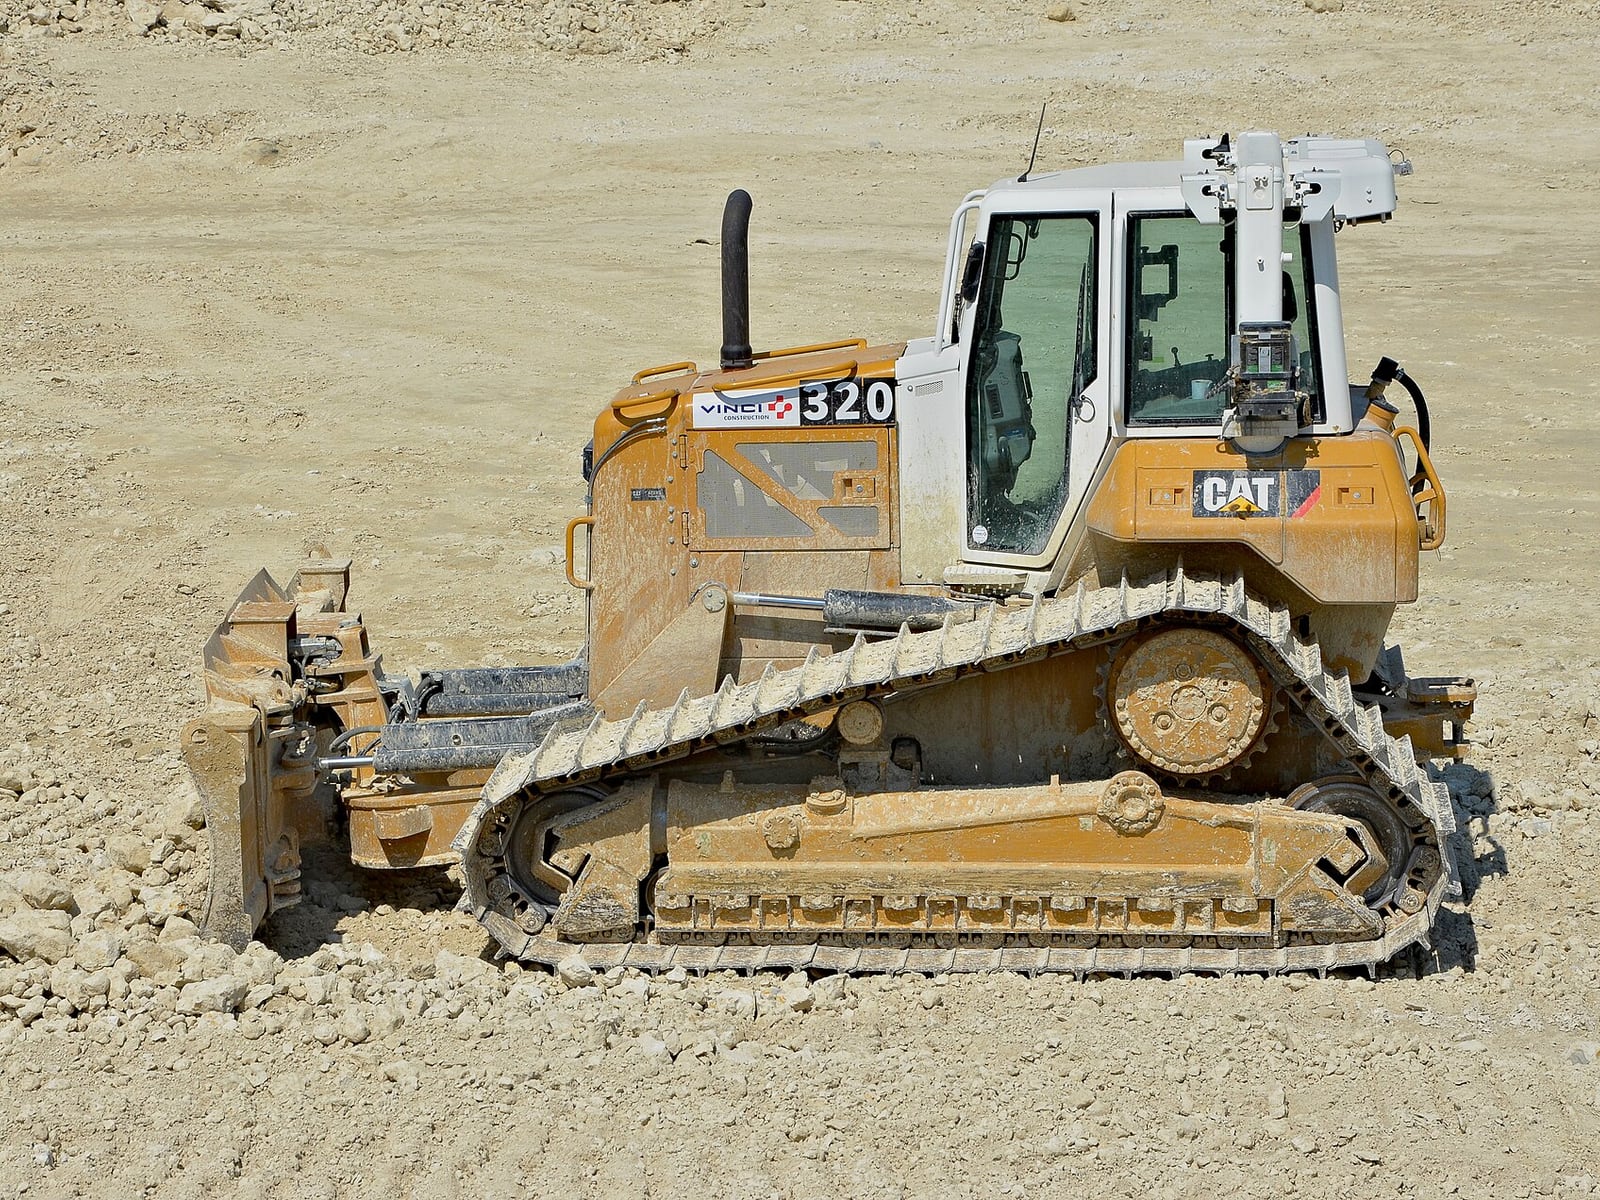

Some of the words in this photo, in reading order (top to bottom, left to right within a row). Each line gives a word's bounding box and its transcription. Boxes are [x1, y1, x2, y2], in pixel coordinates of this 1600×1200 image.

[700, 403, 763, 414] VINCI
[802, 381, 894, 422] 320
[1202, 476, 1275, 512] CAT
